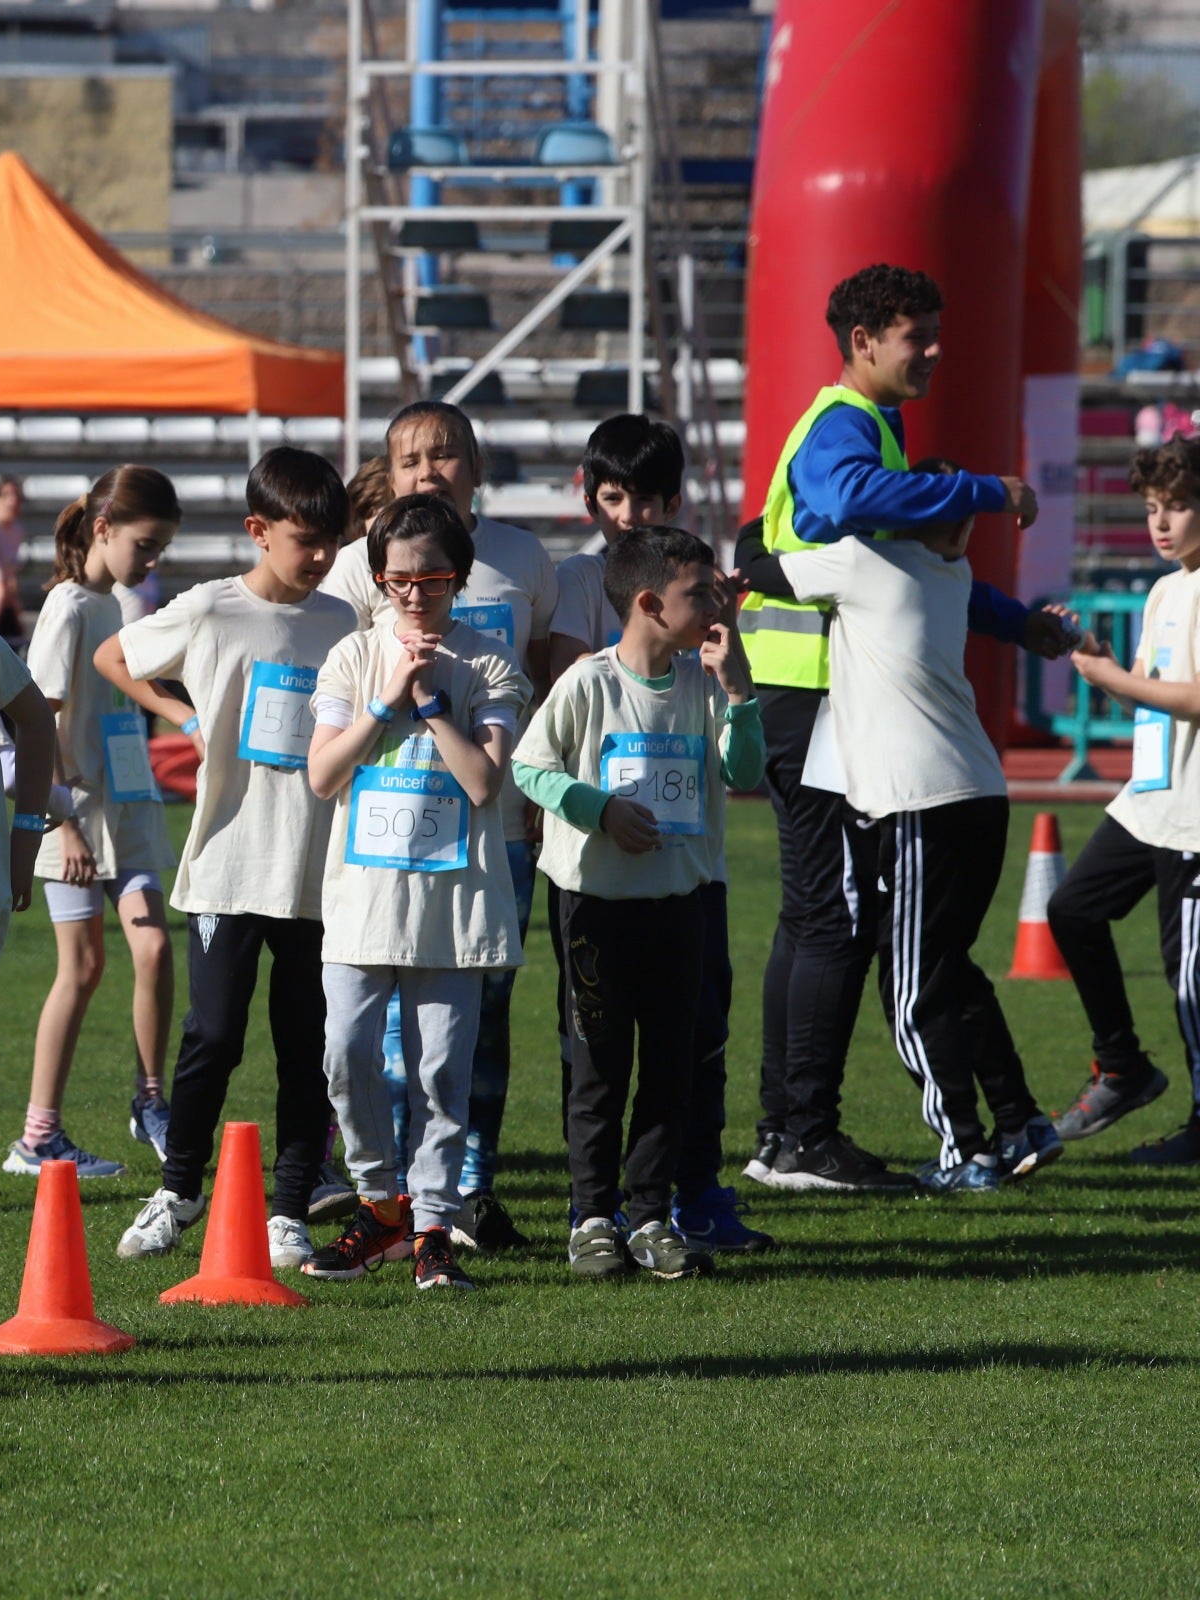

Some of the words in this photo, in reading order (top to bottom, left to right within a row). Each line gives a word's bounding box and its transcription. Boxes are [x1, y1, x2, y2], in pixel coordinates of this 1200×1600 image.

[280, 673, 316, 689] unice
[628, 739, 671, 753] unicef
[381, 774, 428, 790] unicef
[367, 806, 441, 838] 505
